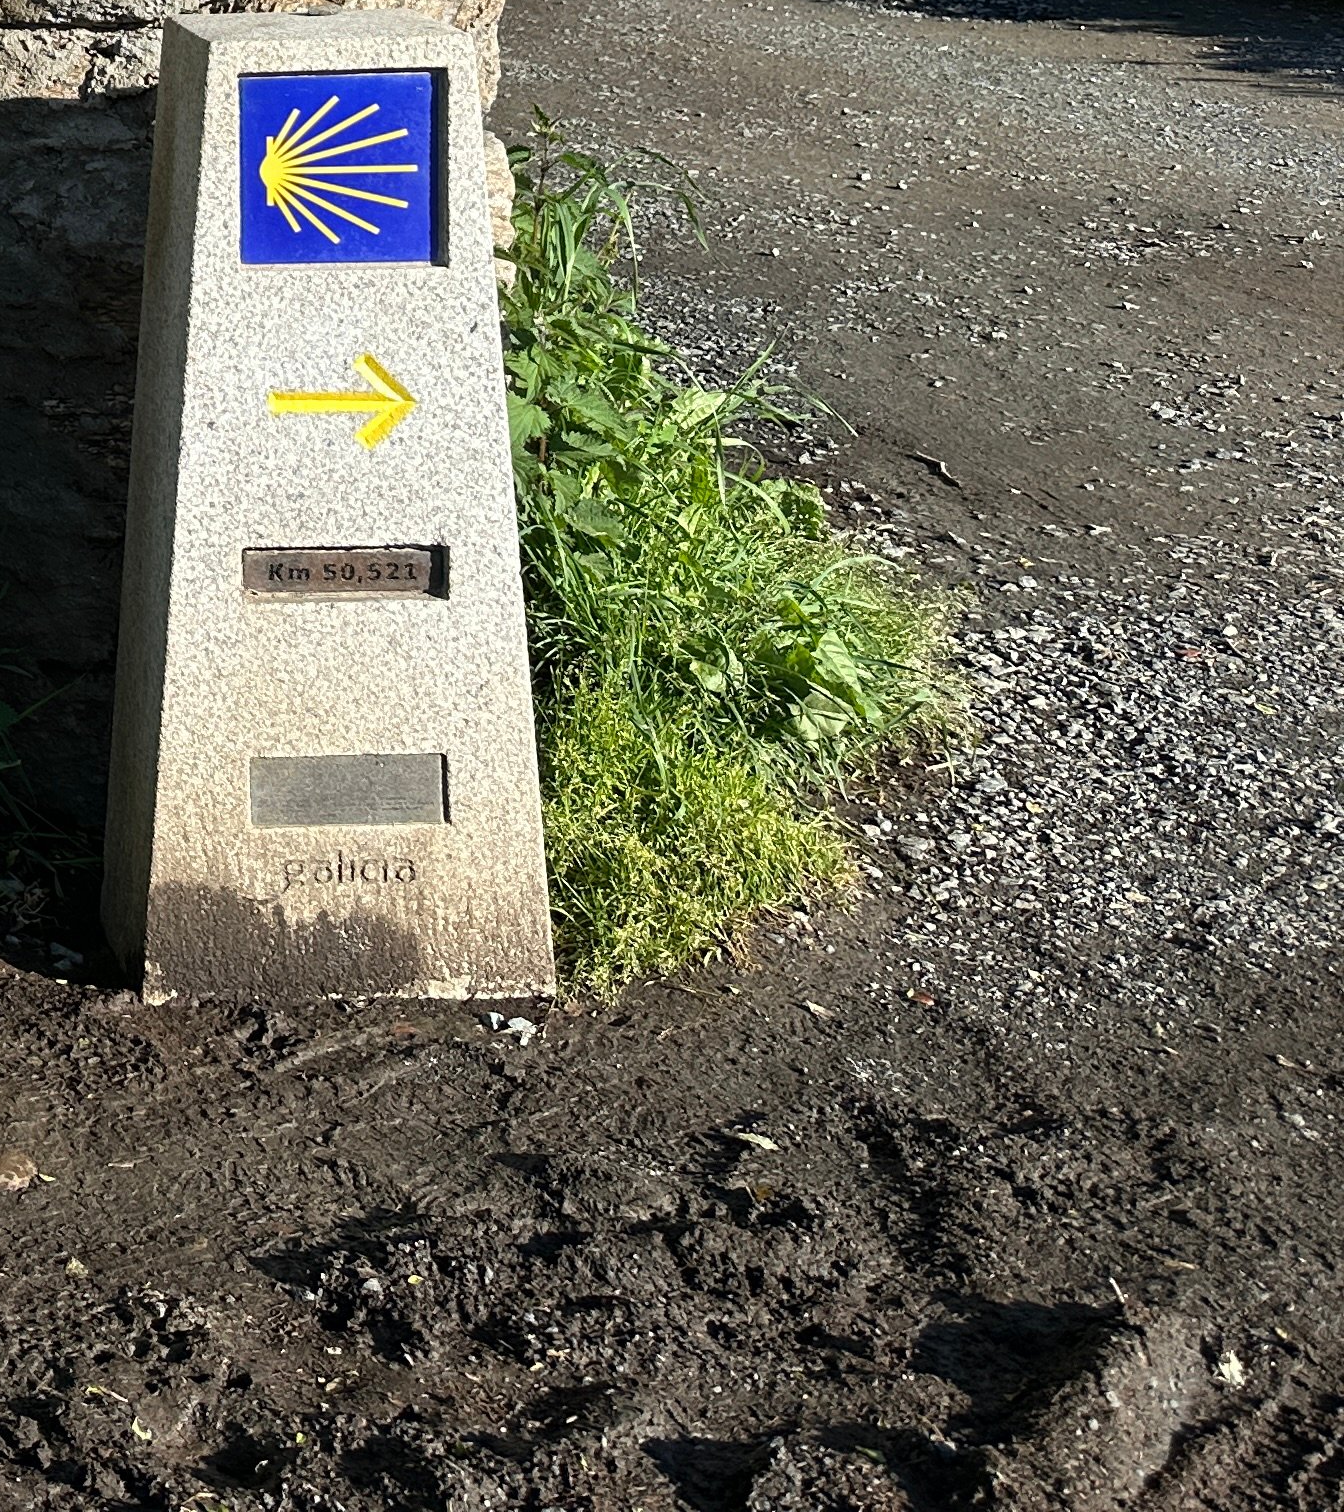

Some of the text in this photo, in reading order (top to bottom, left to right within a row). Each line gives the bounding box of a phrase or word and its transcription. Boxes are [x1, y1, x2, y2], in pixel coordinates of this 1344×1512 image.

[268, 562, 417, 584] Km 50,521
[258, 849, 417, 899] galicia
